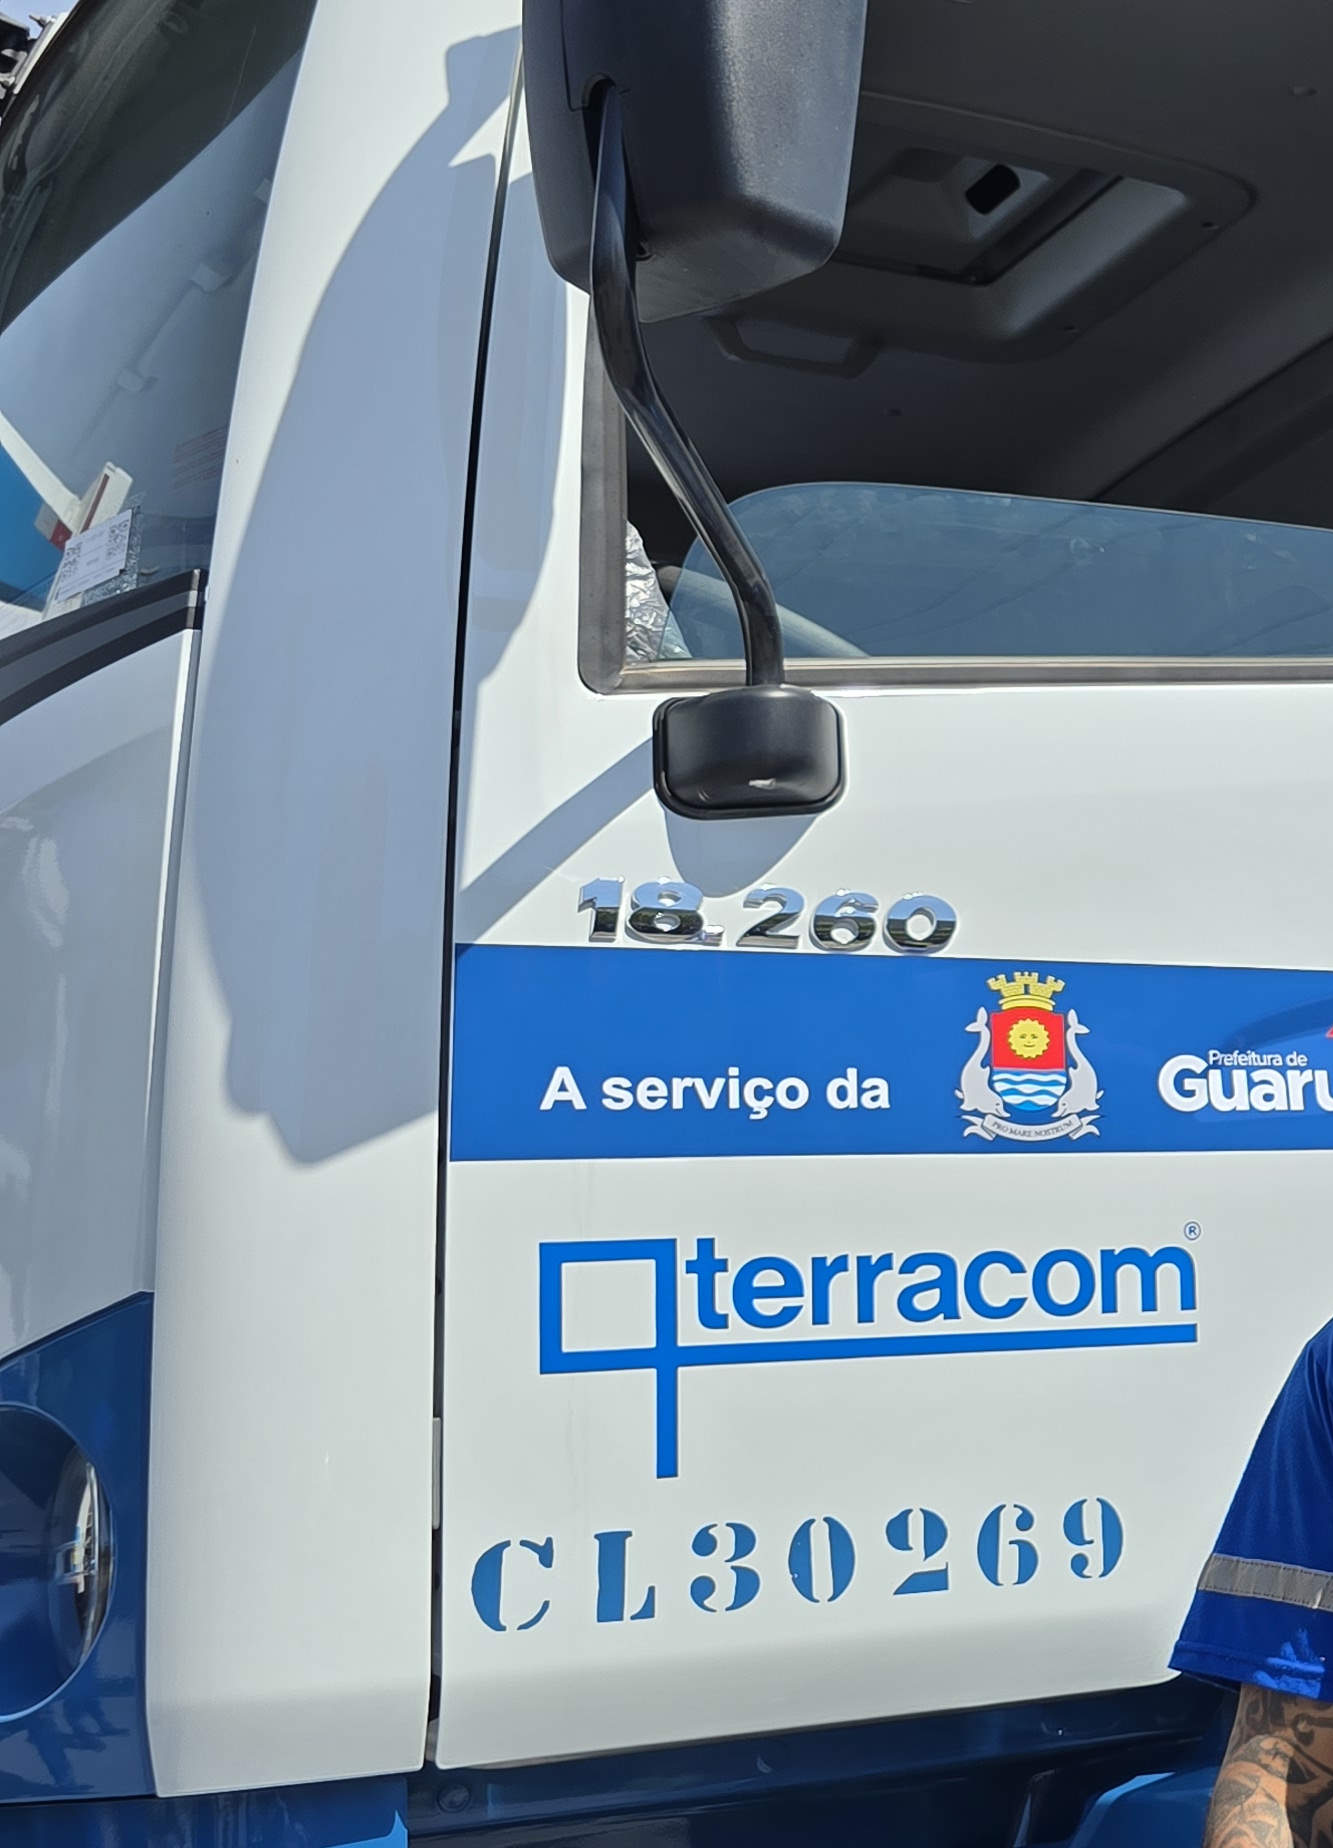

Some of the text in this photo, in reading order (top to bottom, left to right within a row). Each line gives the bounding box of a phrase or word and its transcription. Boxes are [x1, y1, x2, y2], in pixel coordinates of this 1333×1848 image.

[578, 876, 958, 952] 18.260
[540, 1065, 891, 1120] A serviço da
[1208, 1049, 1308, 1067] Prefeitura de
[685, 1236, 1197, 1329] terracom
[470, 1496, 1124, 1632] CL30269
